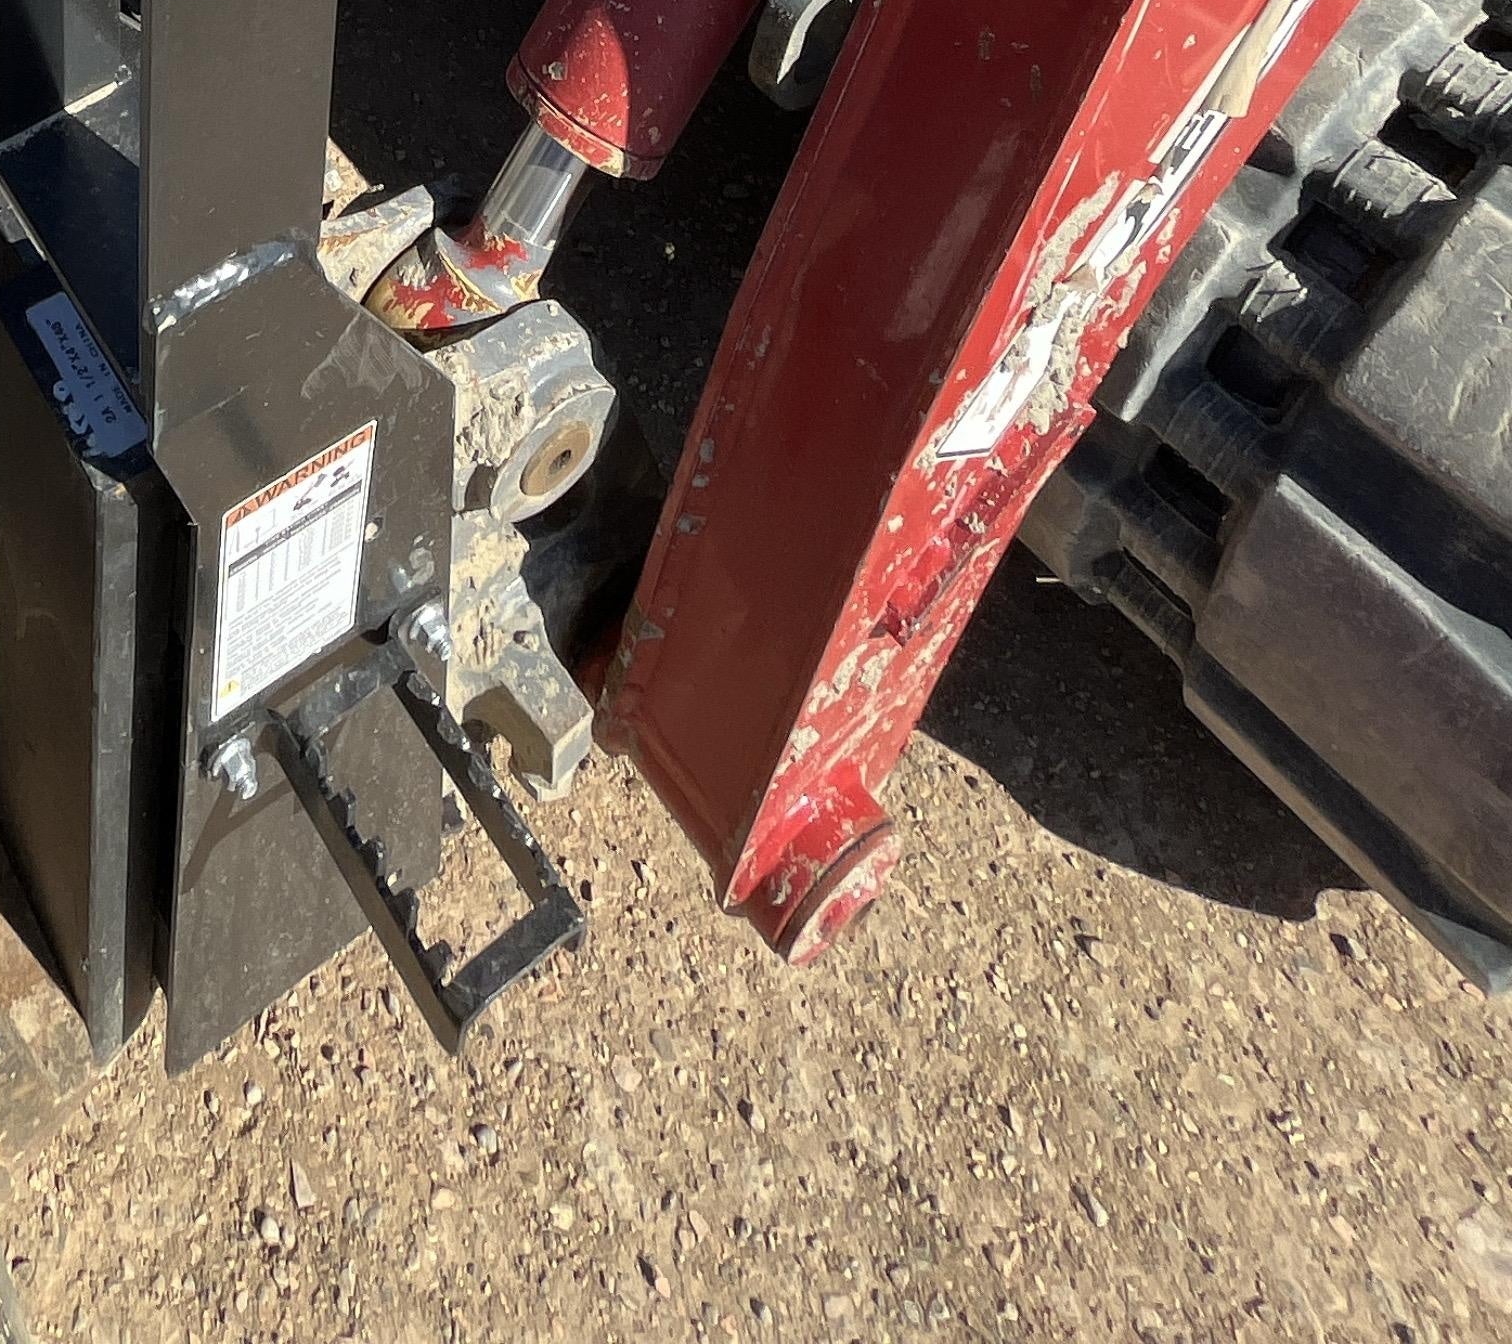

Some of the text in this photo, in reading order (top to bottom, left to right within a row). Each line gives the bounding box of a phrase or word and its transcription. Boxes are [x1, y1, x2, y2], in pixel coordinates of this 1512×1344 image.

[74, 322, 100, 359] CHINA
[111, 386, 134, 414] MADE
[255, 429, 367, 512] WARNING
